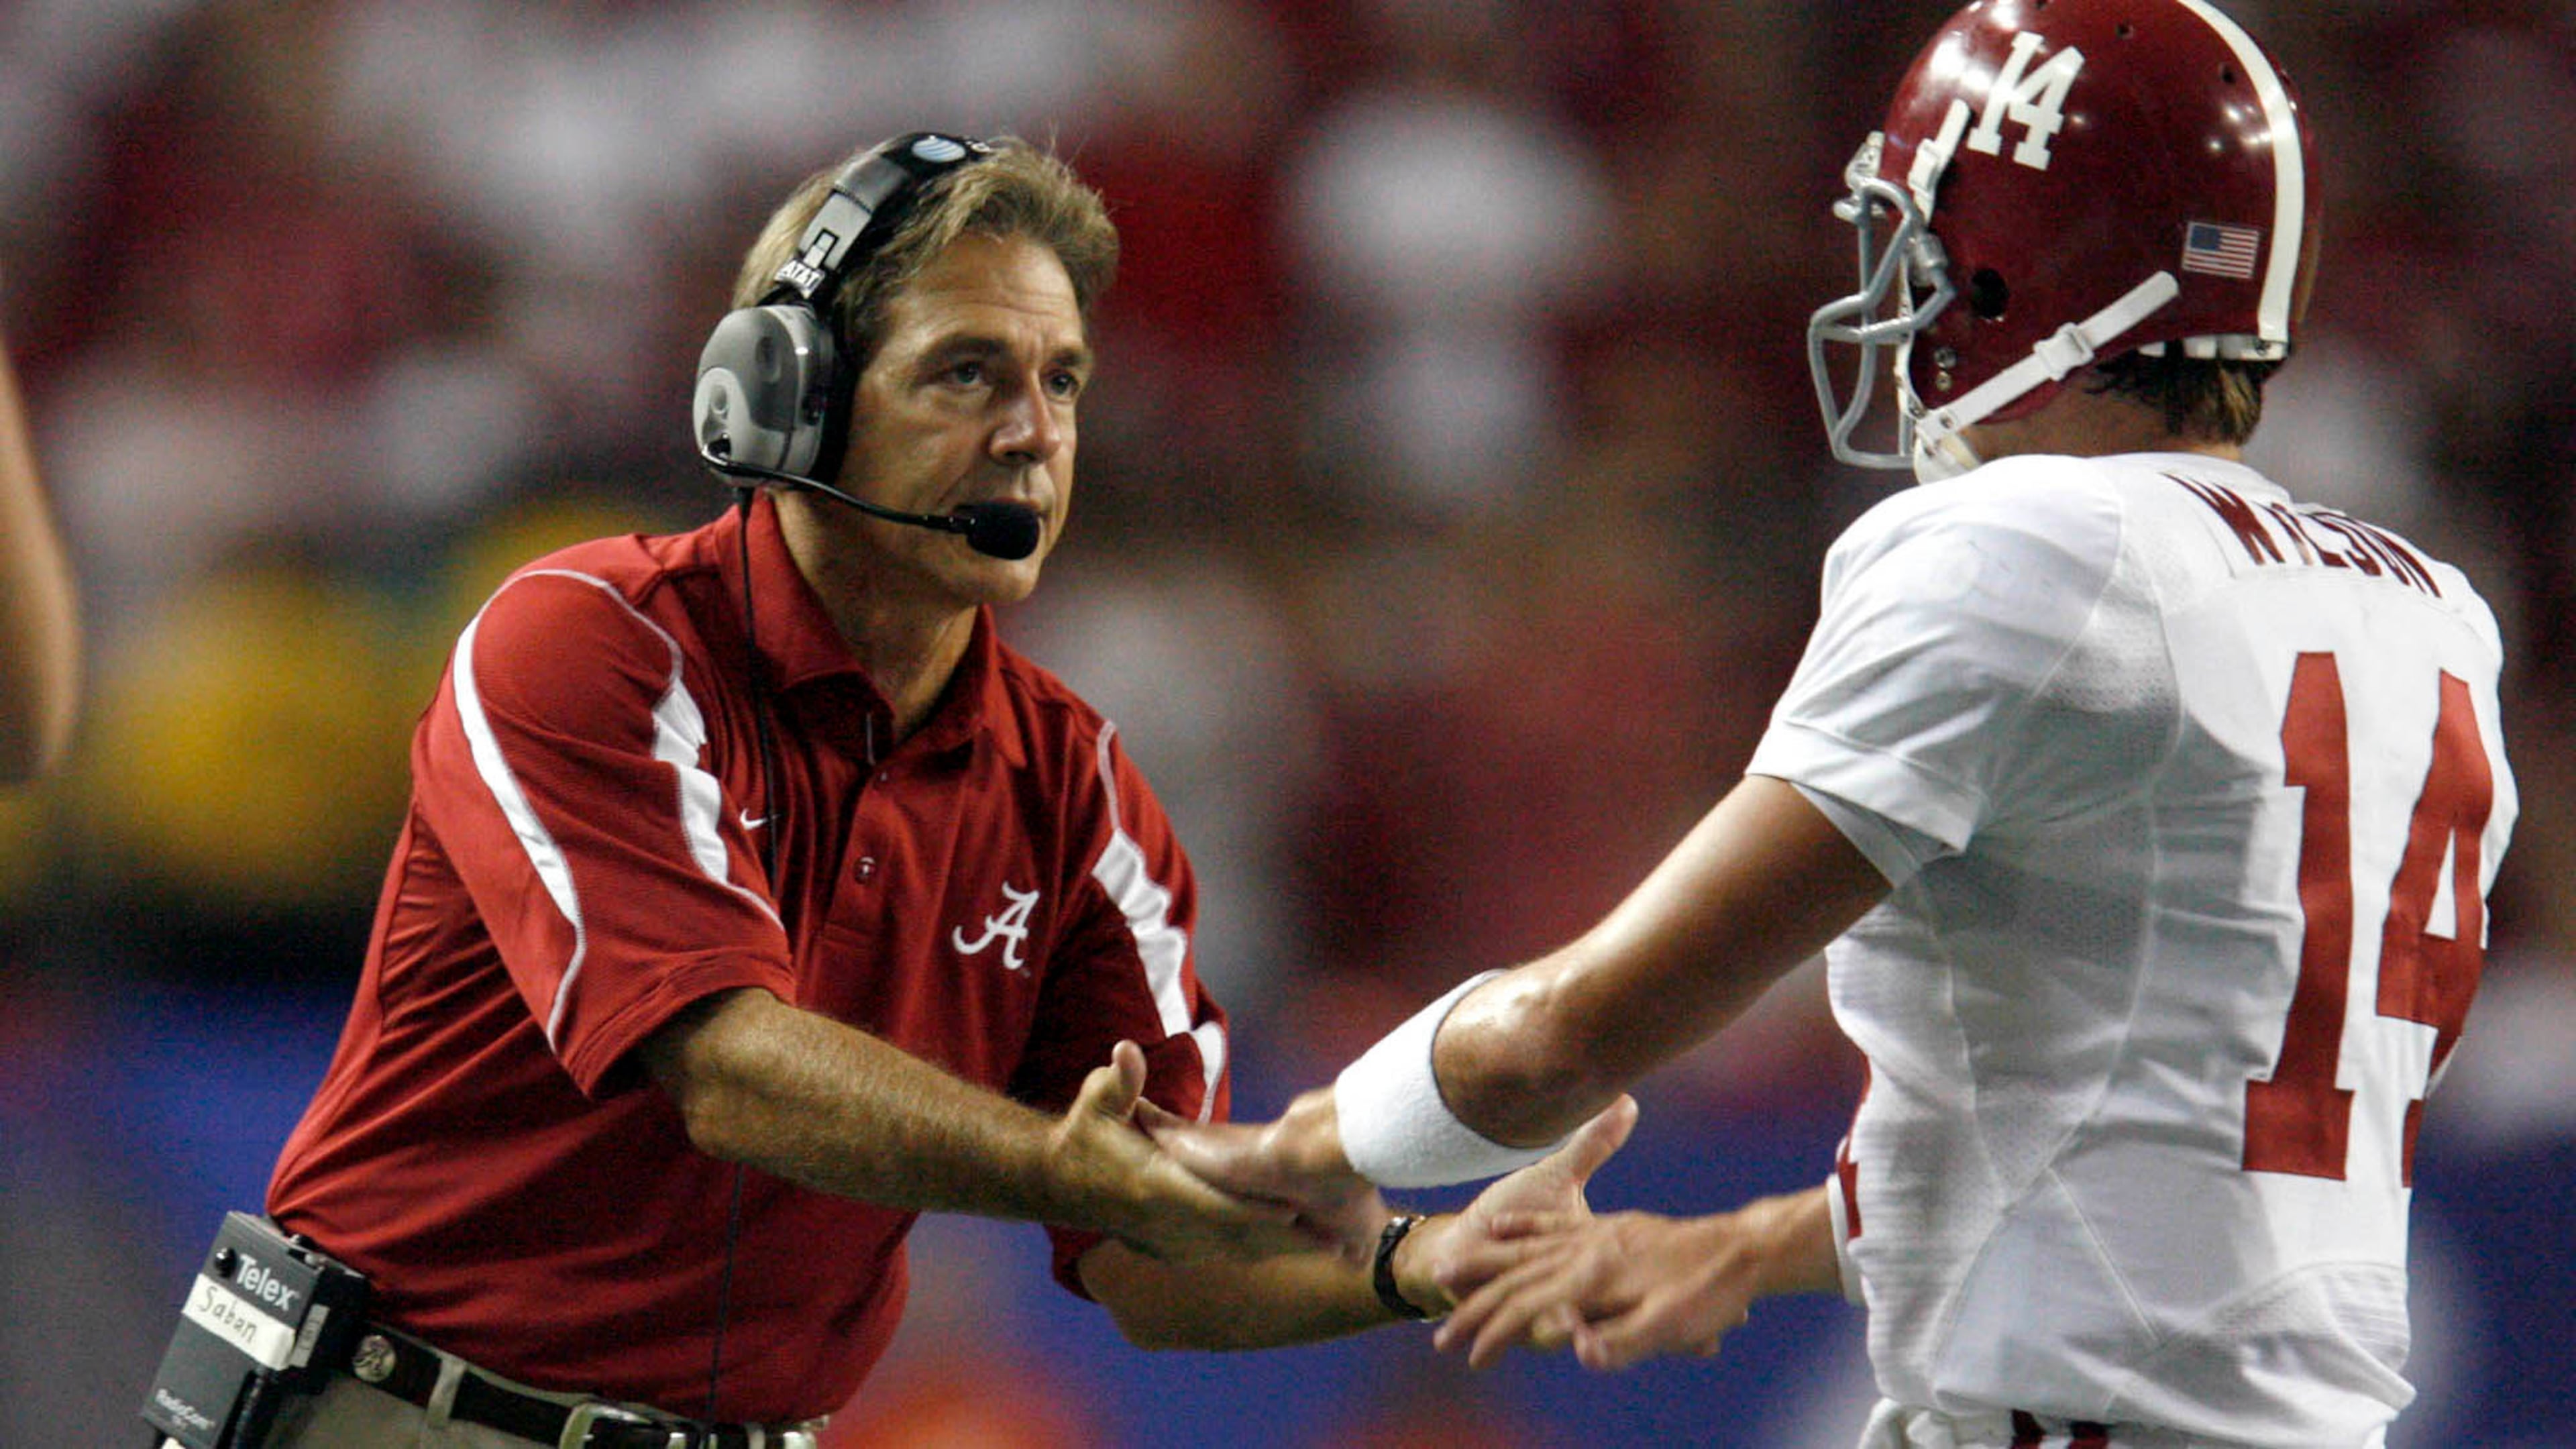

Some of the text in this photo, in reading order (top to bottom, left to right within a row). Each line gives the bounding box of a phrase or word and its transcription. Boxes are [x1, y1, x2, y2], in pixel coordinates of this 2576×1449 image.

[1967, 30, 2085, 170] 14
[952, 880, 1040, 970] A
[2241, 651, 2493, 1189] 14
[198, 1285, 258, 1344] Saban
[237, 1253, 294, 1311] Telex
